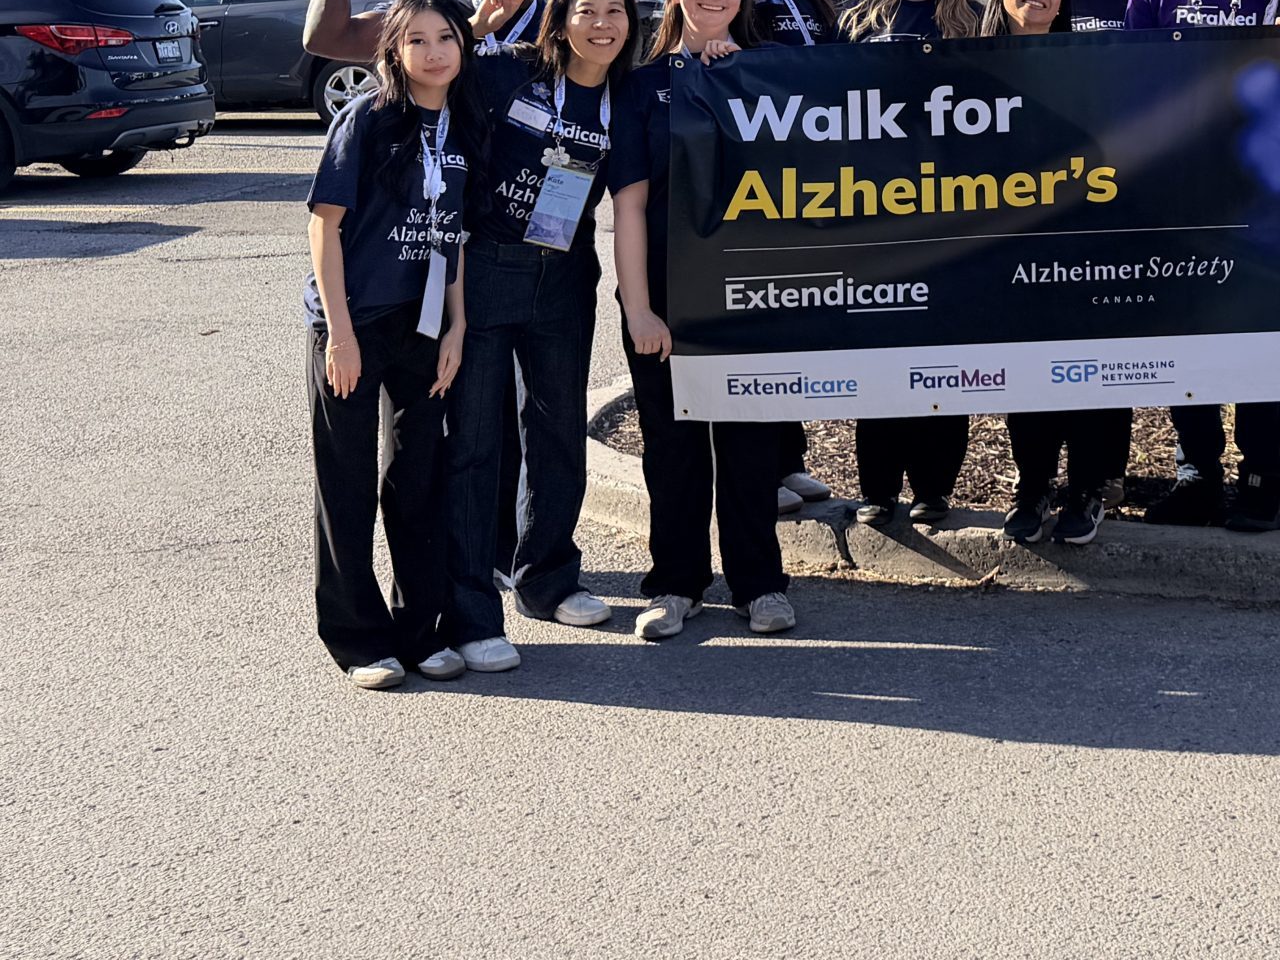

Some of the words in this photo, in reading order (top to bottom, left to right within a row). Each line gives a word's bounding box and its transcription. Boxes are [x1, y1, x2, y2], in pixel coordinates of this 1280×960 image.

[1175, 8, 1257, 26] ParaMed
[728, 89, 907, 141] Walk
[924, 86, 1022, 137] for
[723, 156, 1118, 221] Alzheimer's
[726, 277, 929, 311] Extendicare
[1092, 295, 1157, 305] CANADA
[1051, 363, 1099, 385] SGP
[1101, 361, 1175, 372] PURCHASING
[1101, 371, 1158, 382] NETWORK
[727, 376, 858, 397] Extendicare
[909, 368, 1006, 391] ParaMed
